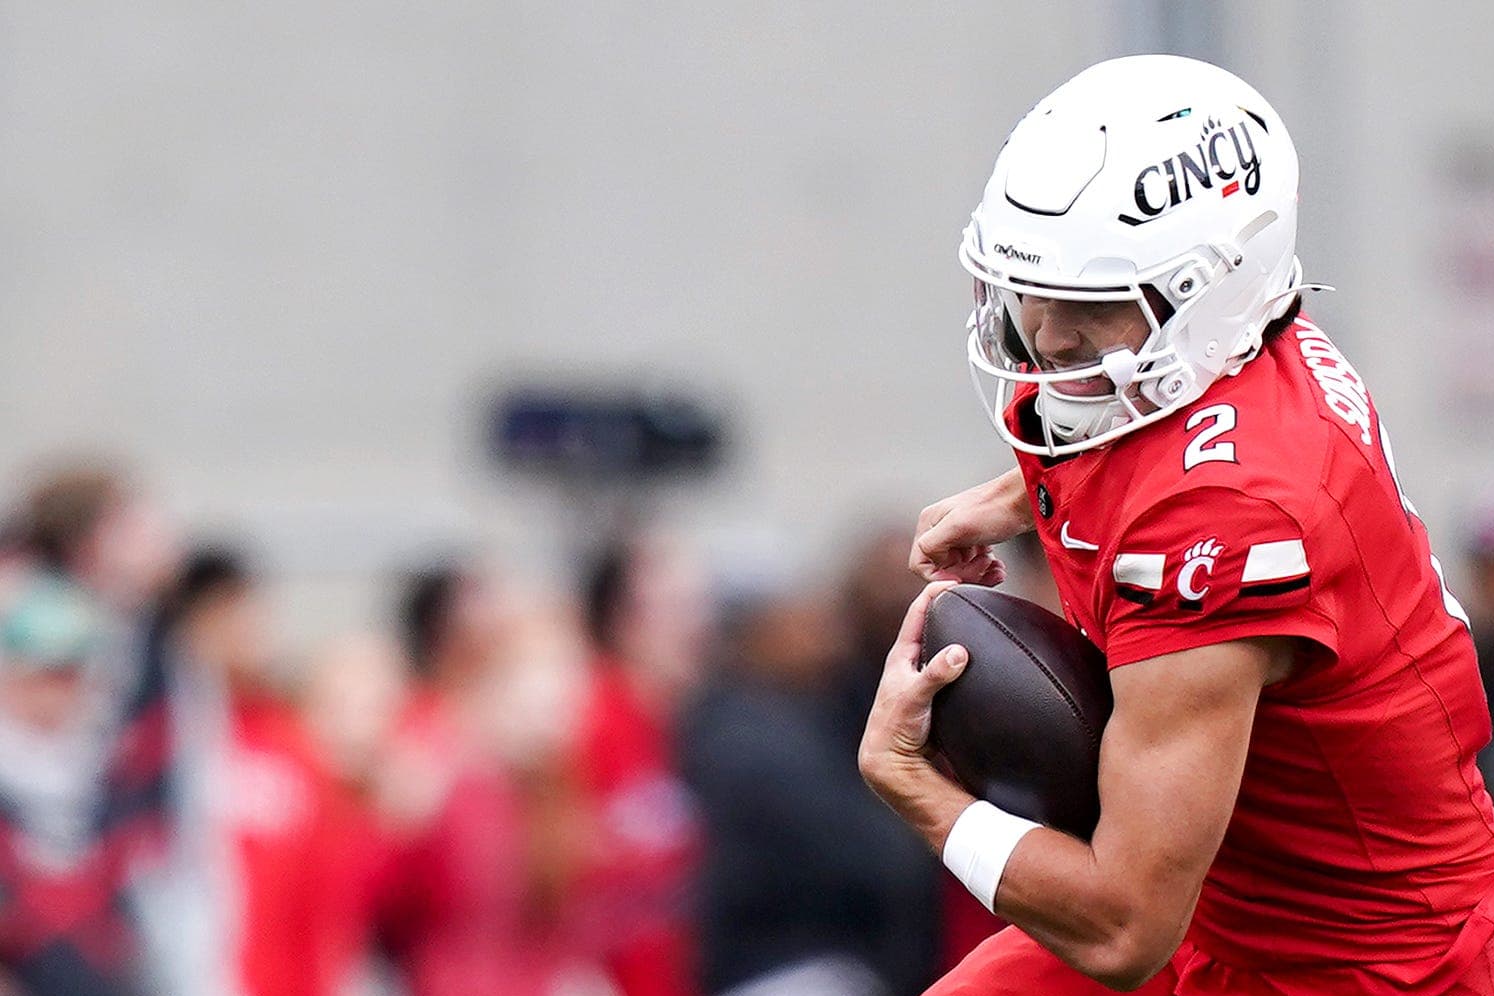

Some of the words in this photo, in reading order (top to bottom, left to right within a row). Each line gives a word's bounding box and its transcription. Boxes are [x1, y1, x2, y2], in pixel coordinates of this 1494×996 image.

[1134, 121, 1262, 216] CINCY
[994, 243, 1042, 265] CINCINNATI
[1183, 403, 1240, 472] 2
